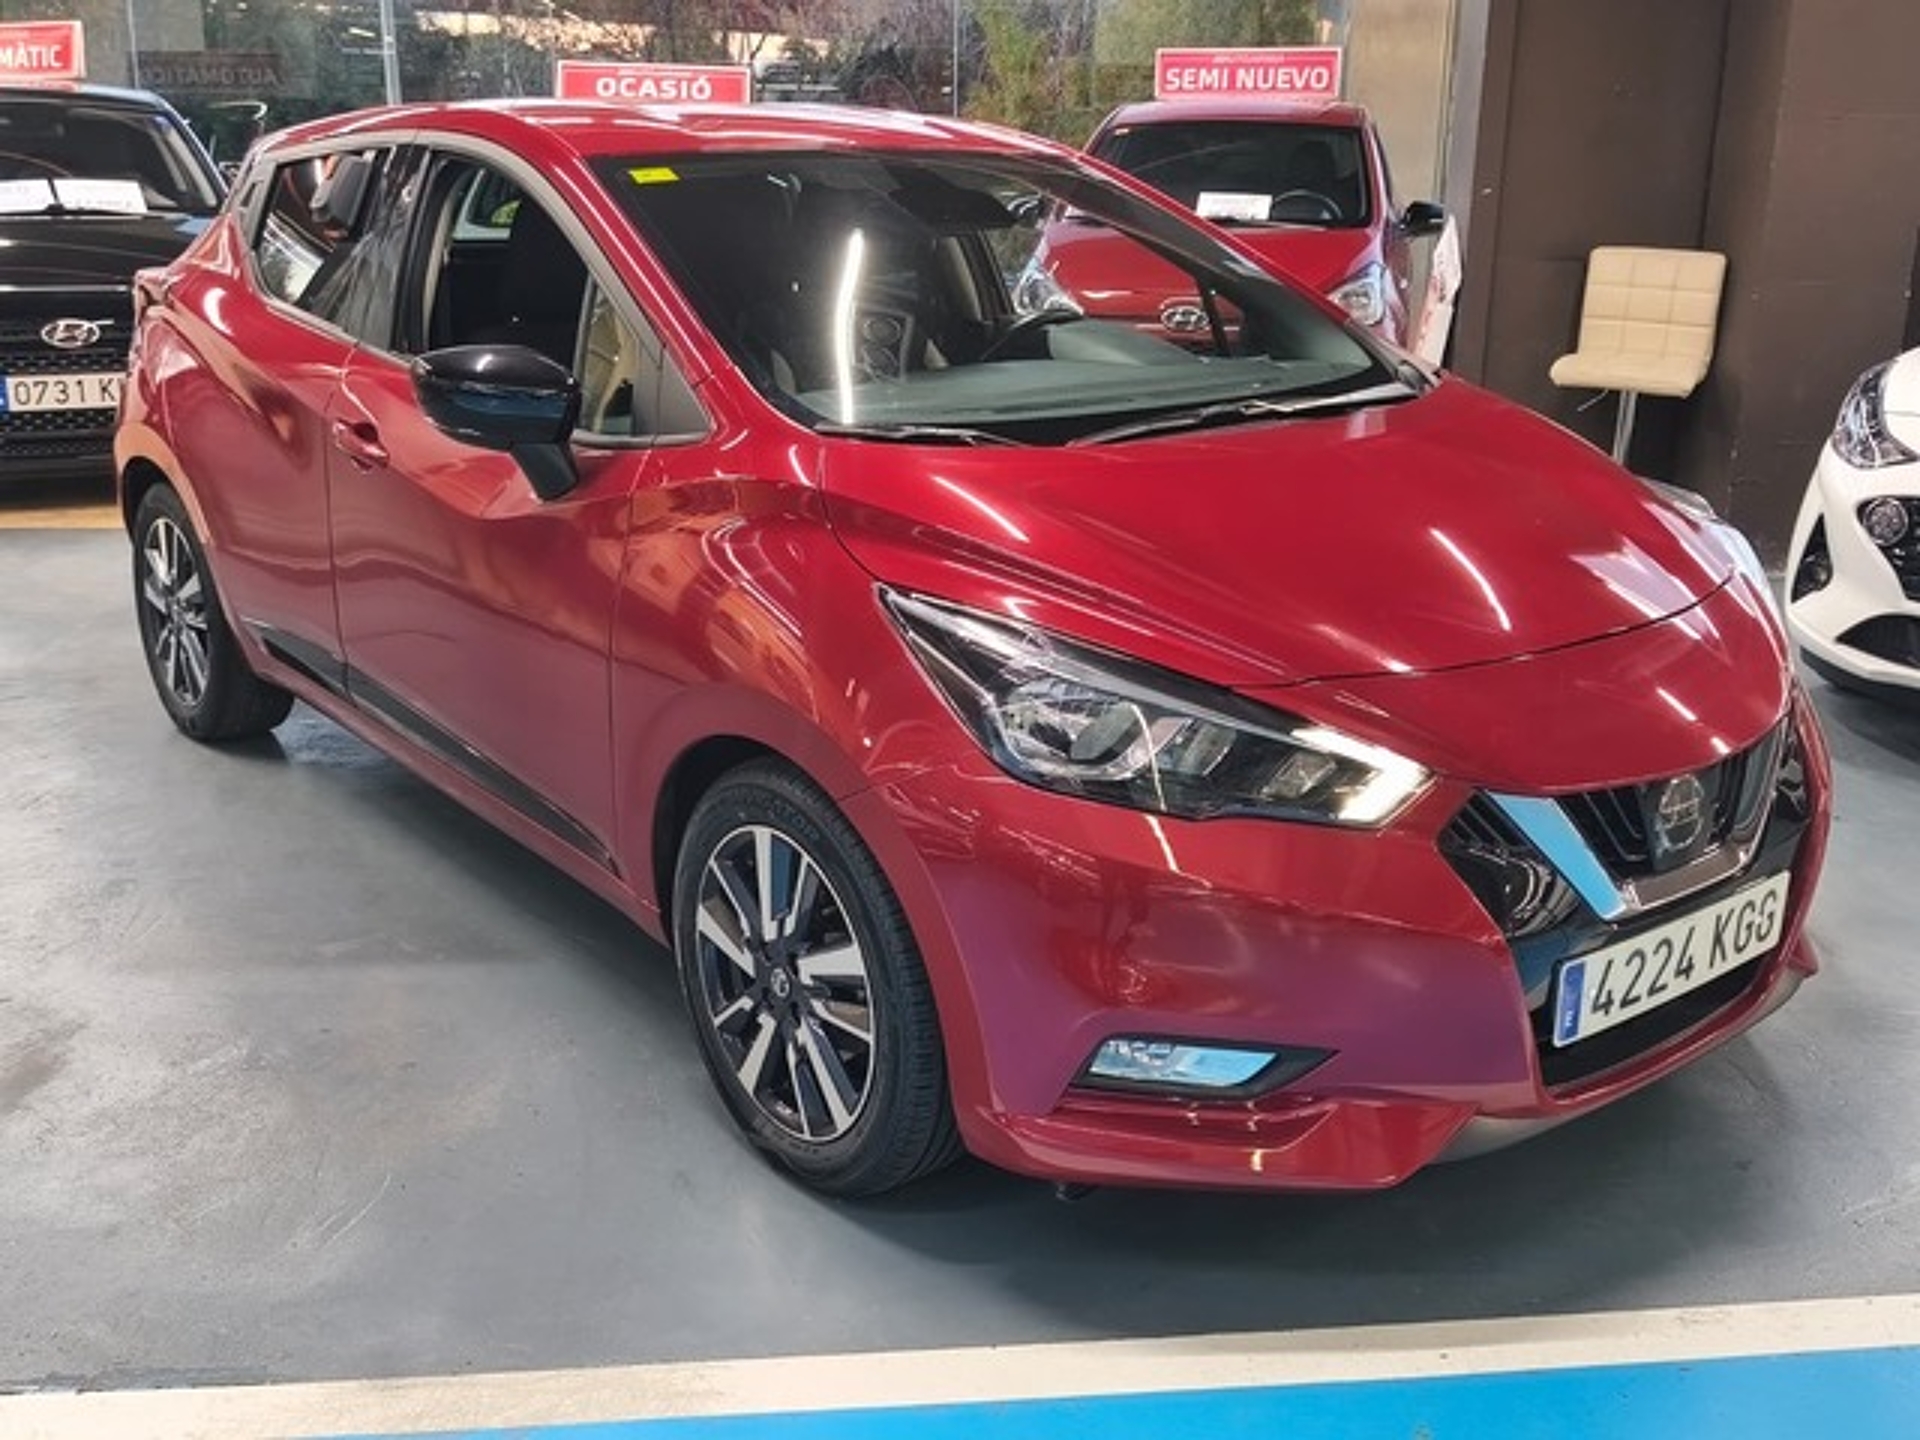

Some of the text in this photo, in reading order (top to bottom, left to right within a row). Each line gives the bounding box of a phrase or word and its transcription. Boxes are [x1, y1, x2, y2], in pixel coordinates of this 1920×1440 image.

[595, 75, 713, 100] OCASIÓ
[1165, 66, 1331, 91] SEMI NUEVO
[14, 377, 122, 406] 0731 K
[1590, 889, 1777, 1017] 4224 KGG
